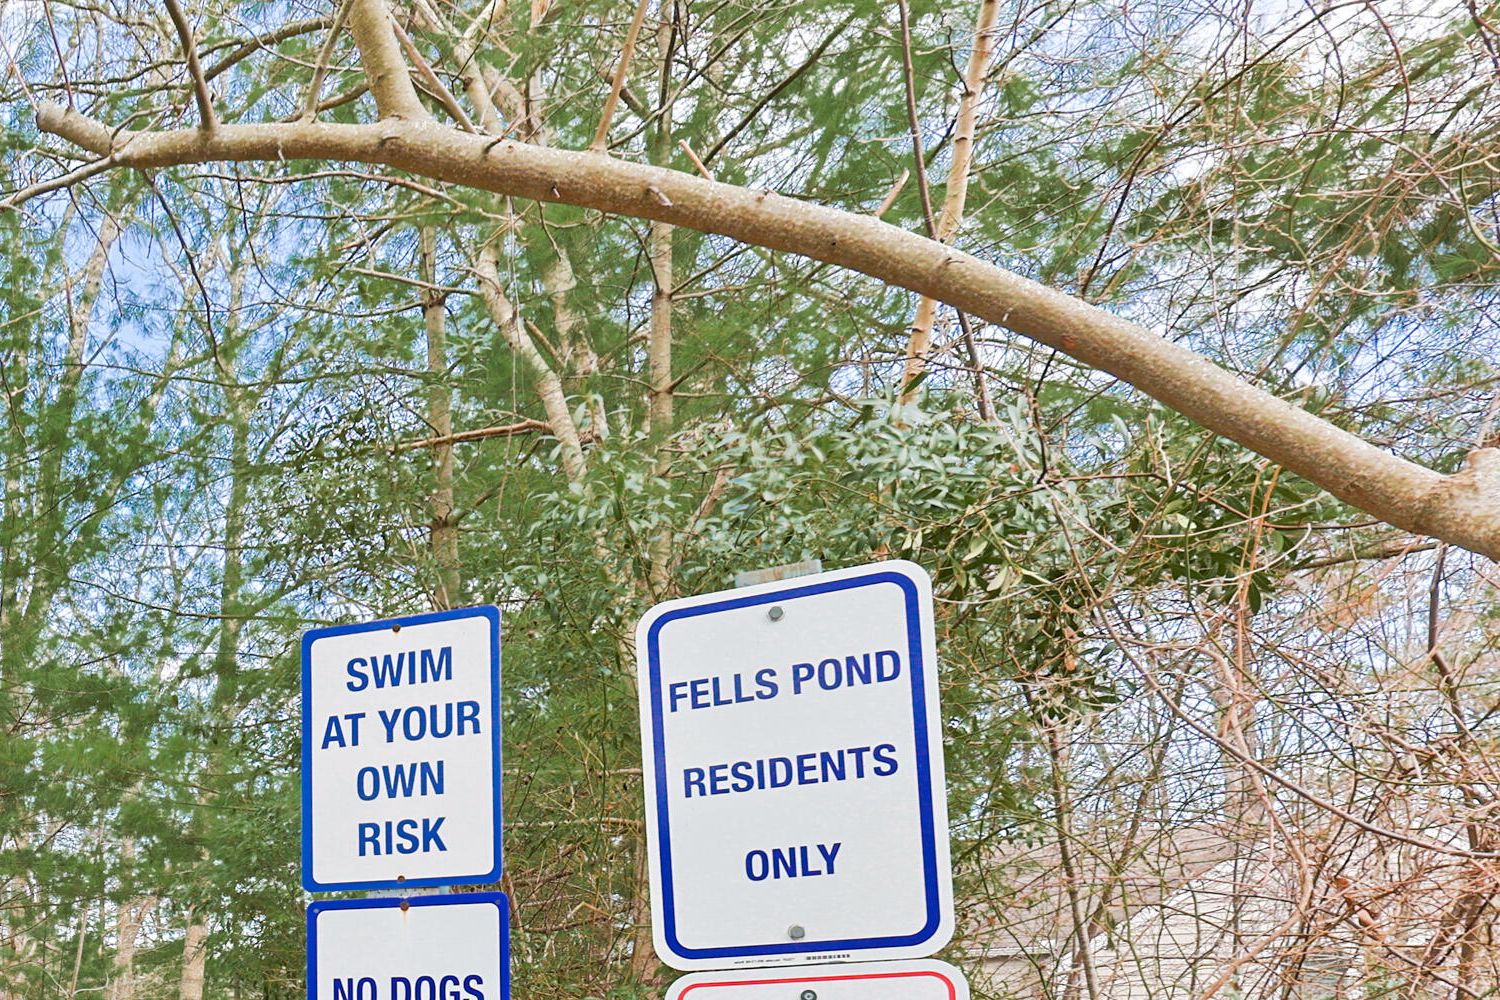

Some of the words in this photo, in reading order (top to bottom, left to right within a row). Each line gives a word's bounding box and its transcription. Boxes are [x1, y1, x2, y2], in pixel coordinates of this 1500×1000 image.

[346, 646, 452, 692] SWIM
[669, 668, 778, 712] FELLS
[792, 650, 900, 695] POND
[321, 712, 366, 749] AT
[378, 700, 481, 743] YOUR
[357, 760, 444, 801] OWN
[683, 743, 898, 798] RESIDENTS
[358, 817, 447, 856] RISK
[745, 842, 841, 881] ONLY
